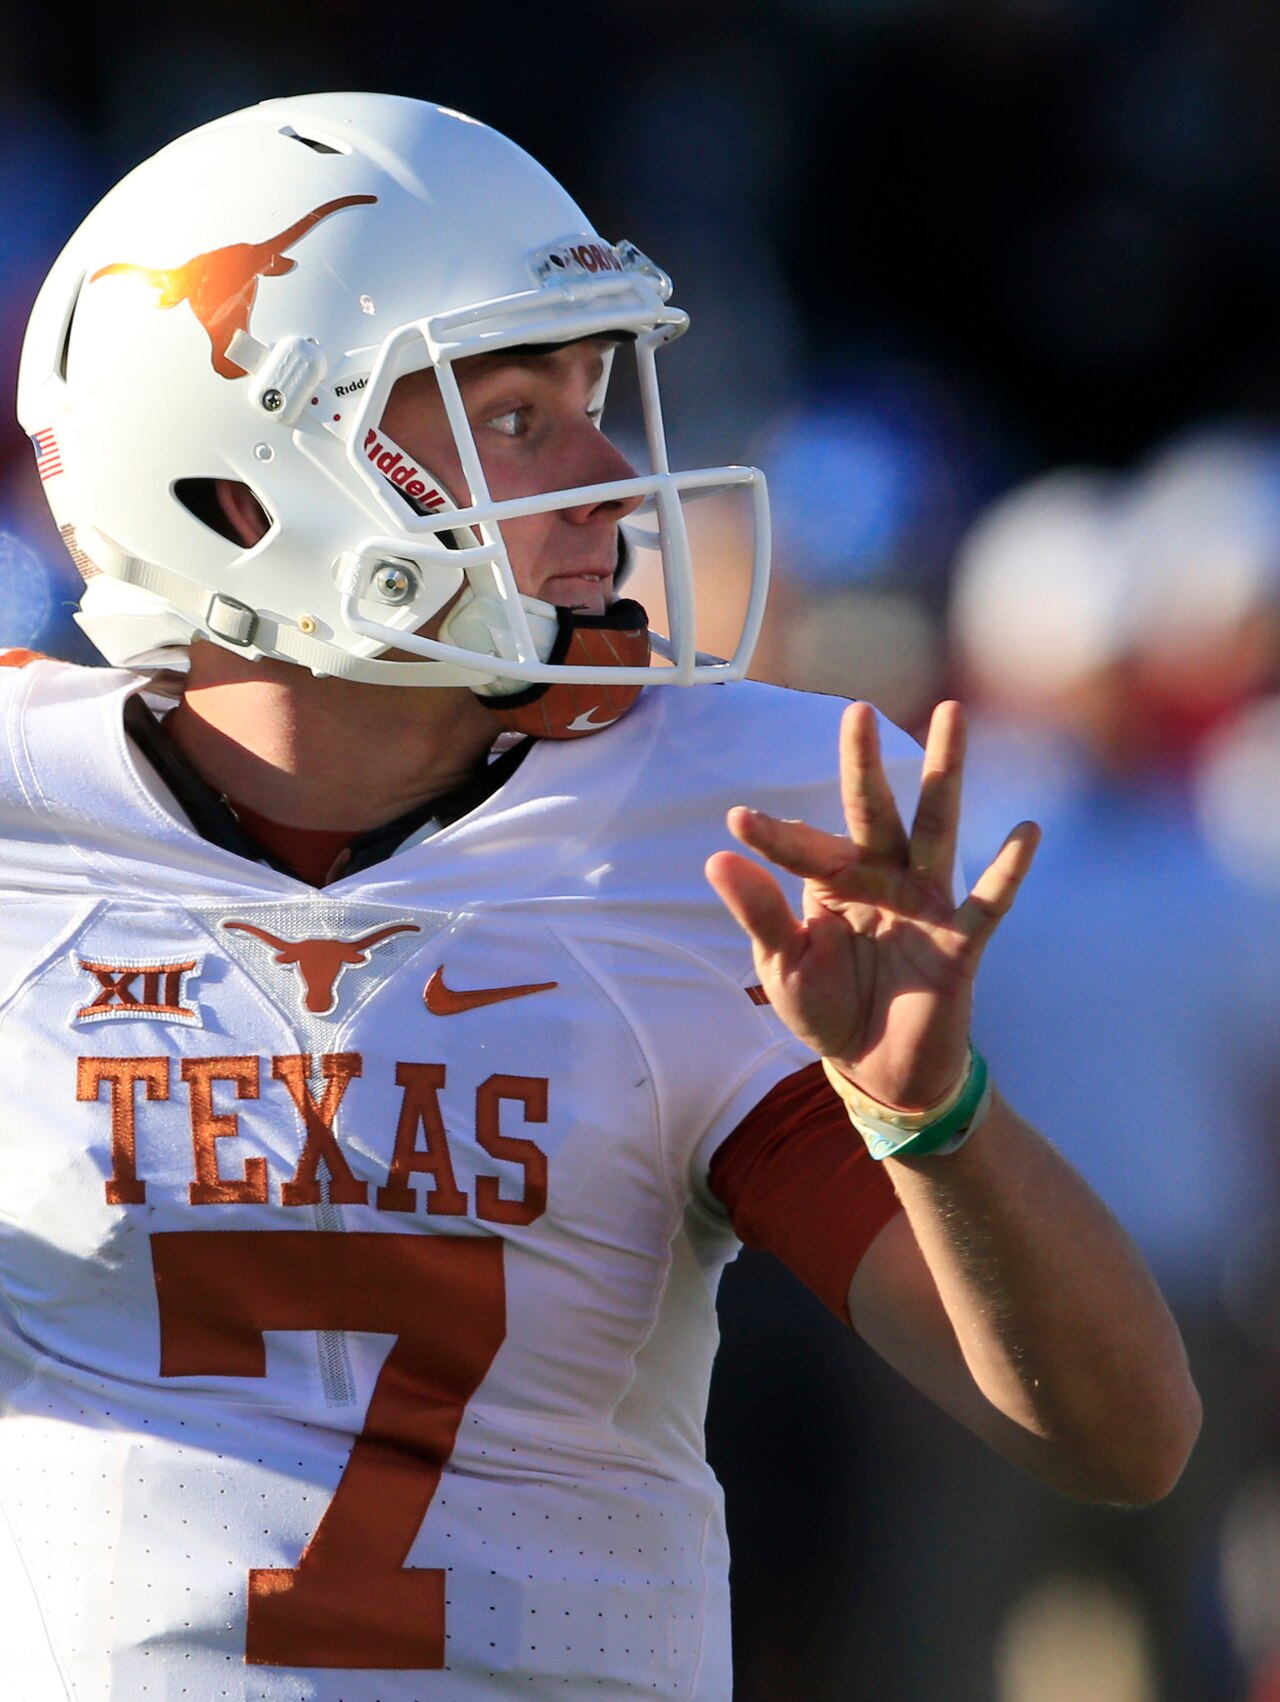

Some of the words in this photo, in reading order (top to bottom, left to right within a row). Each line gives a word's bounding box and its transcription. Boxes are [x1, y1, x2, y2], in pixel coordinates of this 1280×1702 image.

[334, 378, 370, 398] Ridd
[77, 959, 197, 1018] XII
[77, 1053, 549, 1225] TEXAS
[150, 1230, 507, 1670] 7
